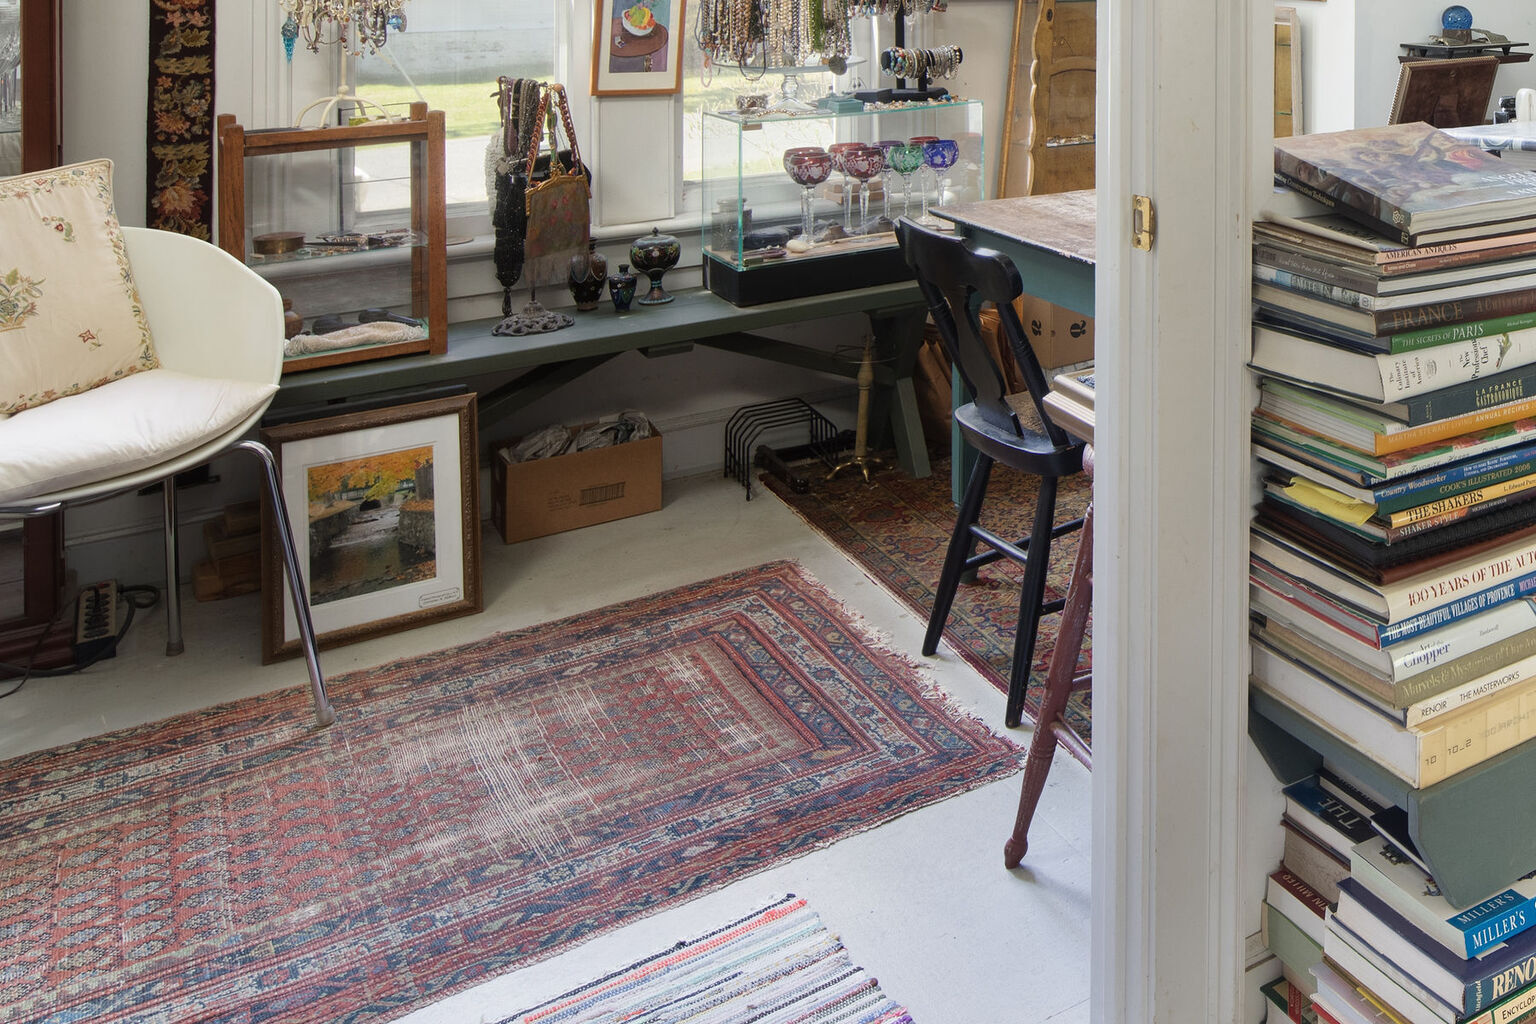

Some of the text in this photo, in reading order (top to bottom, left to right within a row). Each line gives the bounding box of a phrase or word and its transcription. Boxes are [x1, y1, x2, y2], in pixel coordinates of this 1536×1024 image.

[1384, 247, 1422, 260] AMERICAN
[1391, 301, 1464, 329] FRANCE
[1402, 324, 1484, 347] THE SECRETS OF PARIS
[1462, 350, 1471, 369] New
[1481, 345, 1489, 364] Chef
[1388, 404, 1530, 443] MARTHA STEWART ANNUAL RECIPES
[1381, 474, 1447, 498] Country Woodworker
[1440, 468, 1513, 494] COOK'S ILLUSTRATED
[1406, 502, 1431, 522] THE
[1432, 490, 1484, 513] SHAKERS
[1509, 480, 1526, 491] Edward
[1400, 512, 1460, 537] SHAKER STYLE
[1408, 589, 1430, 607] 100
[1431, 577, 1469, 601] YEARS
[1470, 571, 1487, 585] OF
[1489, 561, 1512, 581] THE
[1387, 626, 1400, 641] THE
[1401, 619, 1418, 636] MOST
[1418, 609, 1452, 632] BEAUTIFUL
[1452, 598, 1478, 619] VILLAGES
[1478, 595, 1486, 610] OF
[1486, 583, 1516, 606] PROVENCE
[1403, 642, 1451, 668] Chopper
[1402, 679, 1441, 697] Marvels
[1421, 700, 1447, 717] RENOIR
[1459, 688, 1472, 702] THE
[1474, 671, 1520, 697] MASTERWORKS
[1318, 798, 1360, 829] THE
[1457, 892, 1515, 925] MILLER'S
[1473, 910, 1526, 950] MILLER'S
